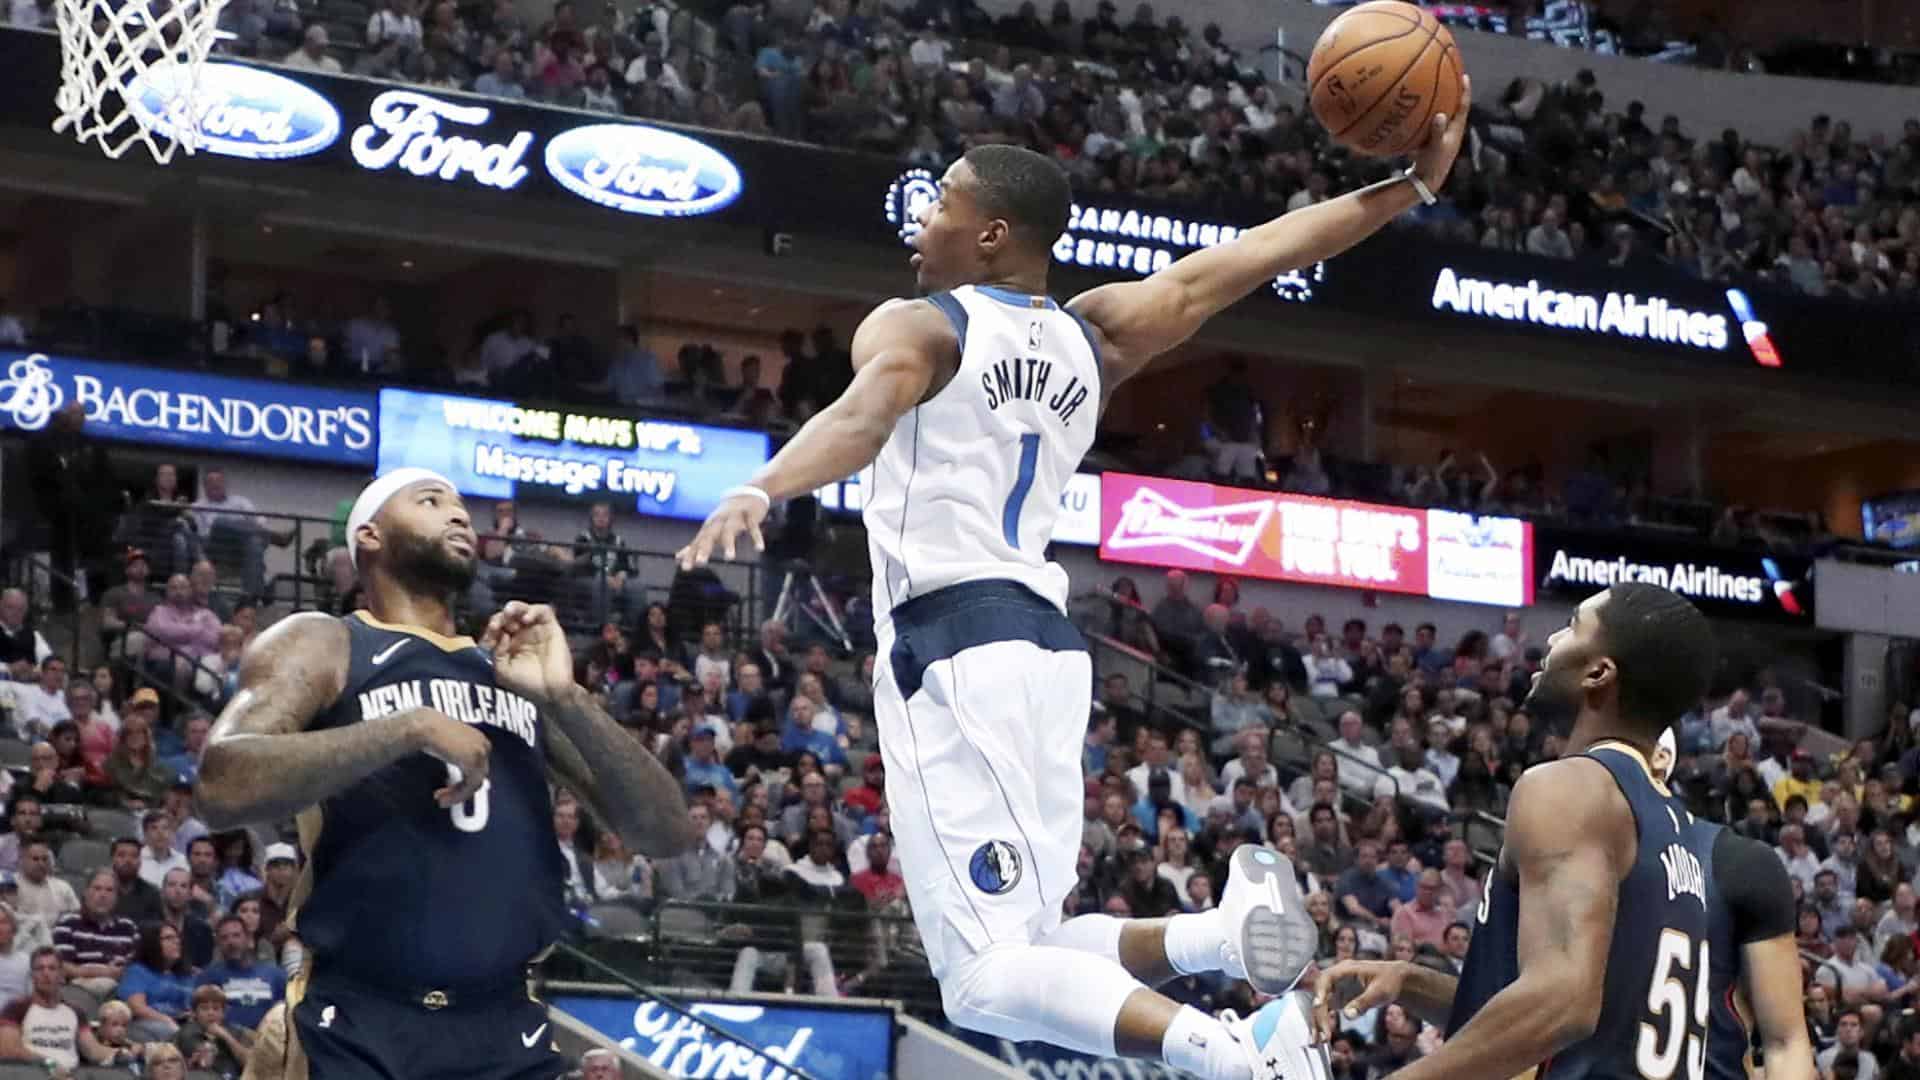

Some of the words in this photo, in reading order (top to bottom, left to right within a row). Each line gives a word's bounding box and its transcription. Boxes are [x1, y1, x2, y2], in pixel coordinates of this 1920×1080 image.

[352, 90, 533, 189] Ford
[583, 139, 700, 201] Ford
[1052, 233, 1172, 274] CENTER
[1432, 268, 1599, 331] American
[1599, 292, 1728, 350] Airlines
[73, 374, 371, 450] BACHENDORF'S
[983, 358, 1052, 411] SMITH
[1050, 376, 1088, 427] JR.
[475, 443, 602, 494] Massage
[607, 458, 677, 502] Envy
[1002, 433, 1041, 550] 1
[1550, 550, 1669, 590] American
[1669, 563, 1763, 602] Airlines
[358, 680, 424, 721] NEW
[430, 679, 538, 747] ORLEANS
[618, 1001, 813, 1080] Ford
